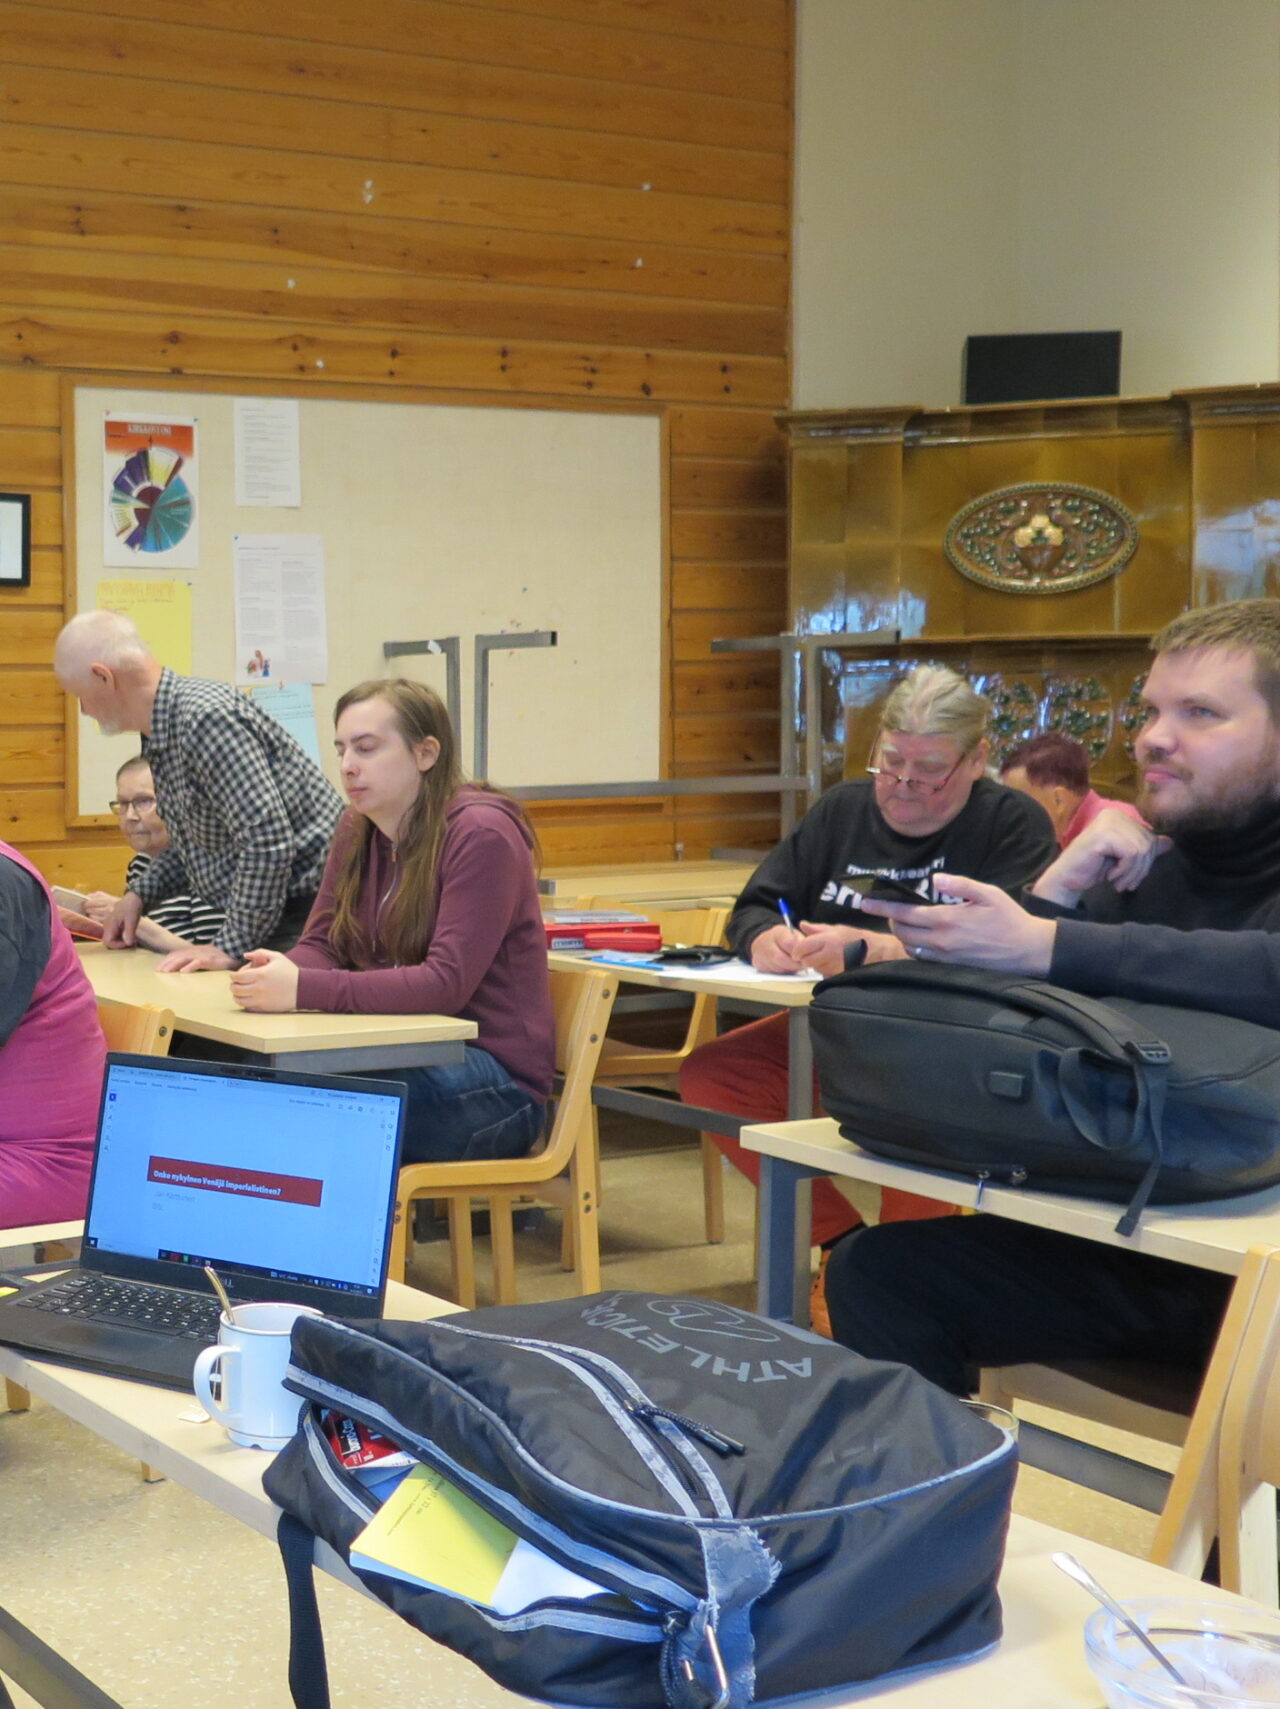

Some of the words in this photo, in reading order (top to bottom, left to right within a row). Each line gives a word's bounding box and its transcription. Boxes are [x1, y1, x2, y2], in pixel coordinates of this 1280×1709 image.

[153, 1170, 171, 1180] Onko
[171, 1173, 202, 1185] nykyinen
[202, 1177, 225, 1189] Venäjä
[225, 1179, 282, 1196] imperialistinen?
